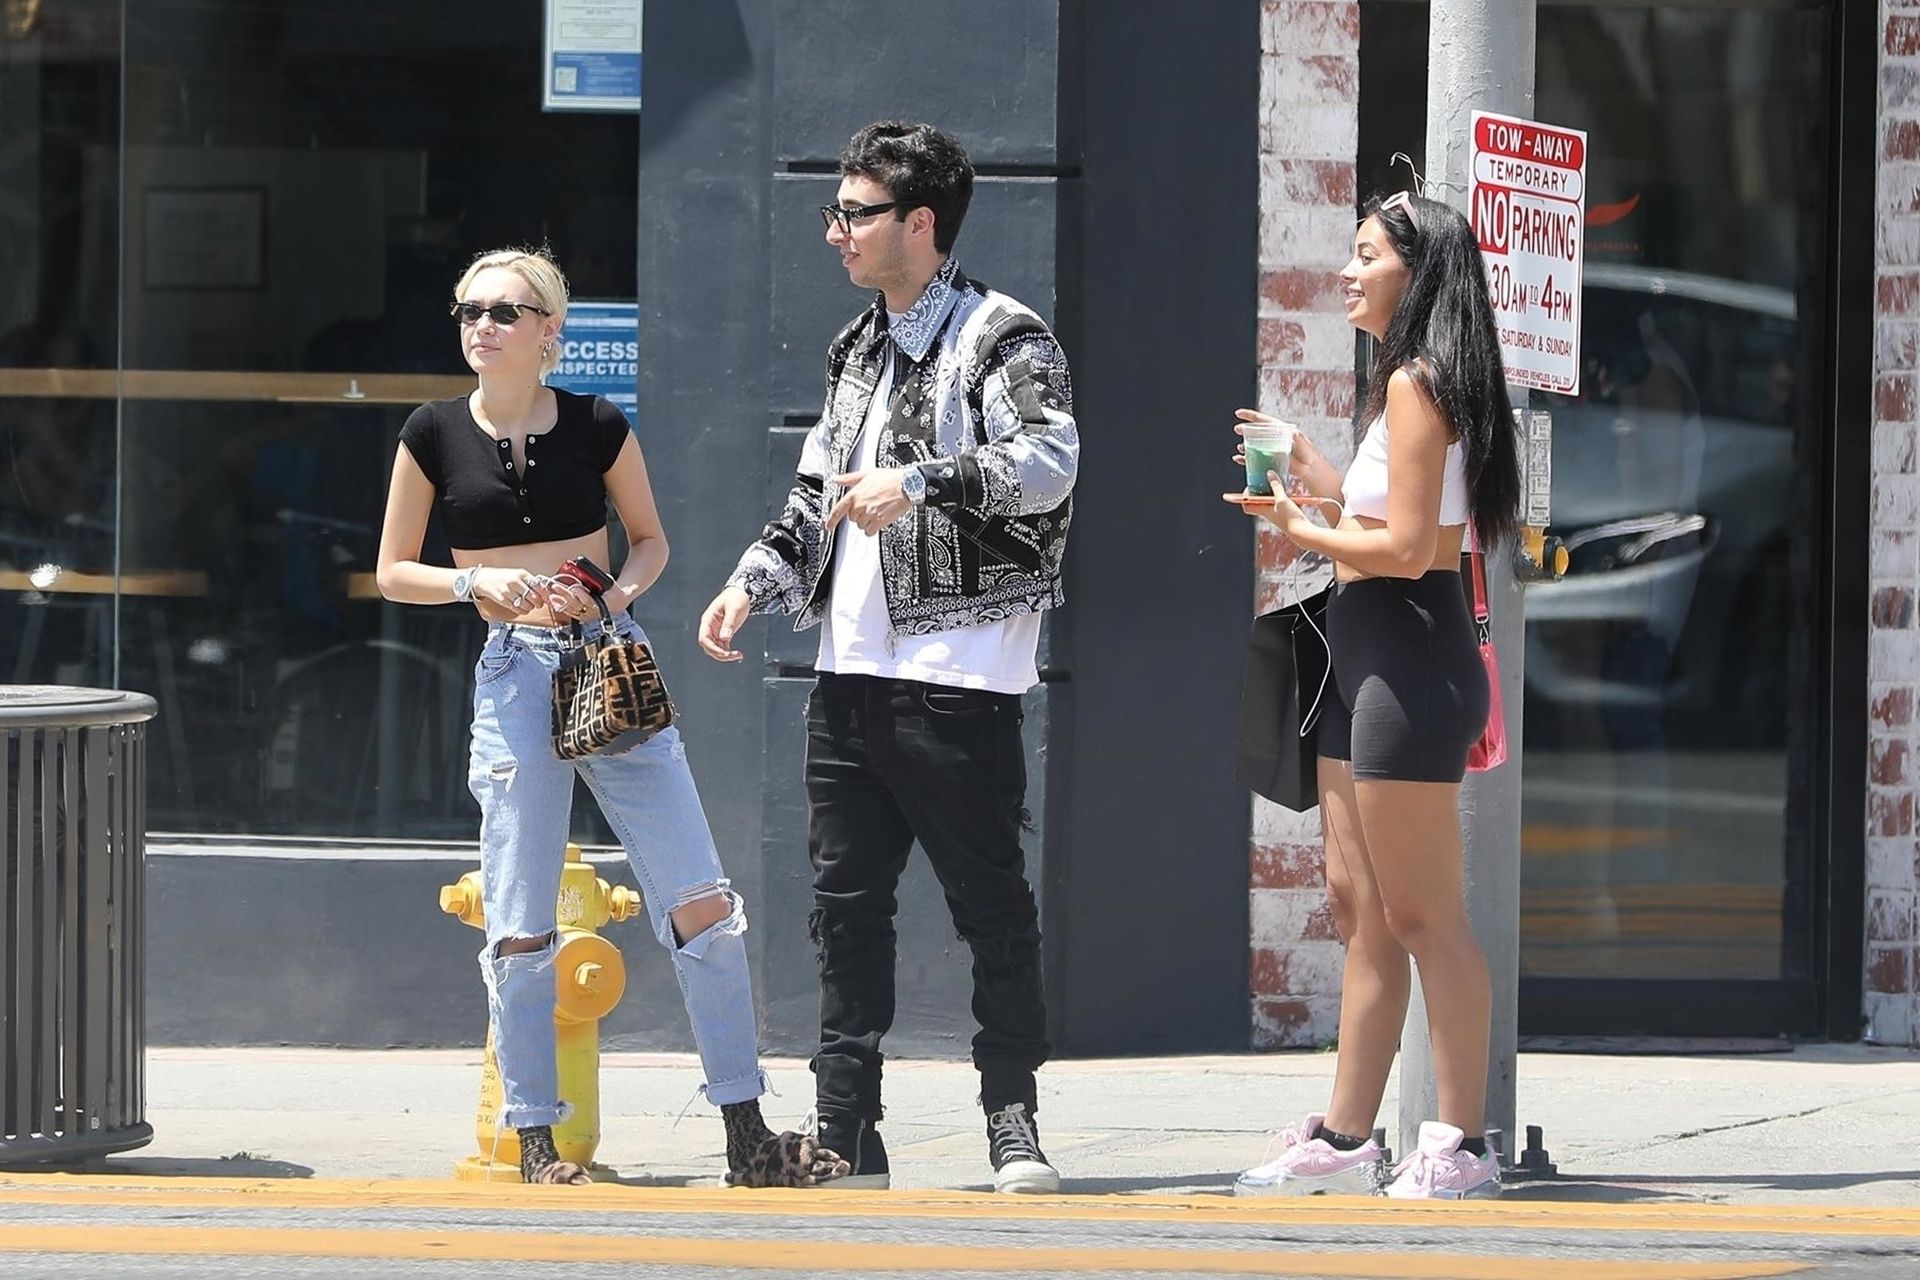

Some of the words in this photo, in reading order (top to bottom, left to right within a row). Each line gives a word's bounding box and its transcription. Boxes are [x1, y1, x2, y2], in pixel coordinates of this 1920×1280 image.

[1487, 123, 1573, 163] TOW-AWAY
[1490, 160, 1568, 192] TEMPORARY
[1477, 188, 1507, 249] NO
[1512, 205, 1575, 262] PARKING
[1488, 263, 1527, 315] 30AM
[561, 341, 638, 360] CCESS
[1501, 328, 1536, 350] SATURDAY
[1538, 335, 1543, 351] &
[1546, 336, 1573, 357] SUNDAY
[555, 362, 638, 375] NSPECTED
[1504, 367, 1529, 379] MPOUNDED
